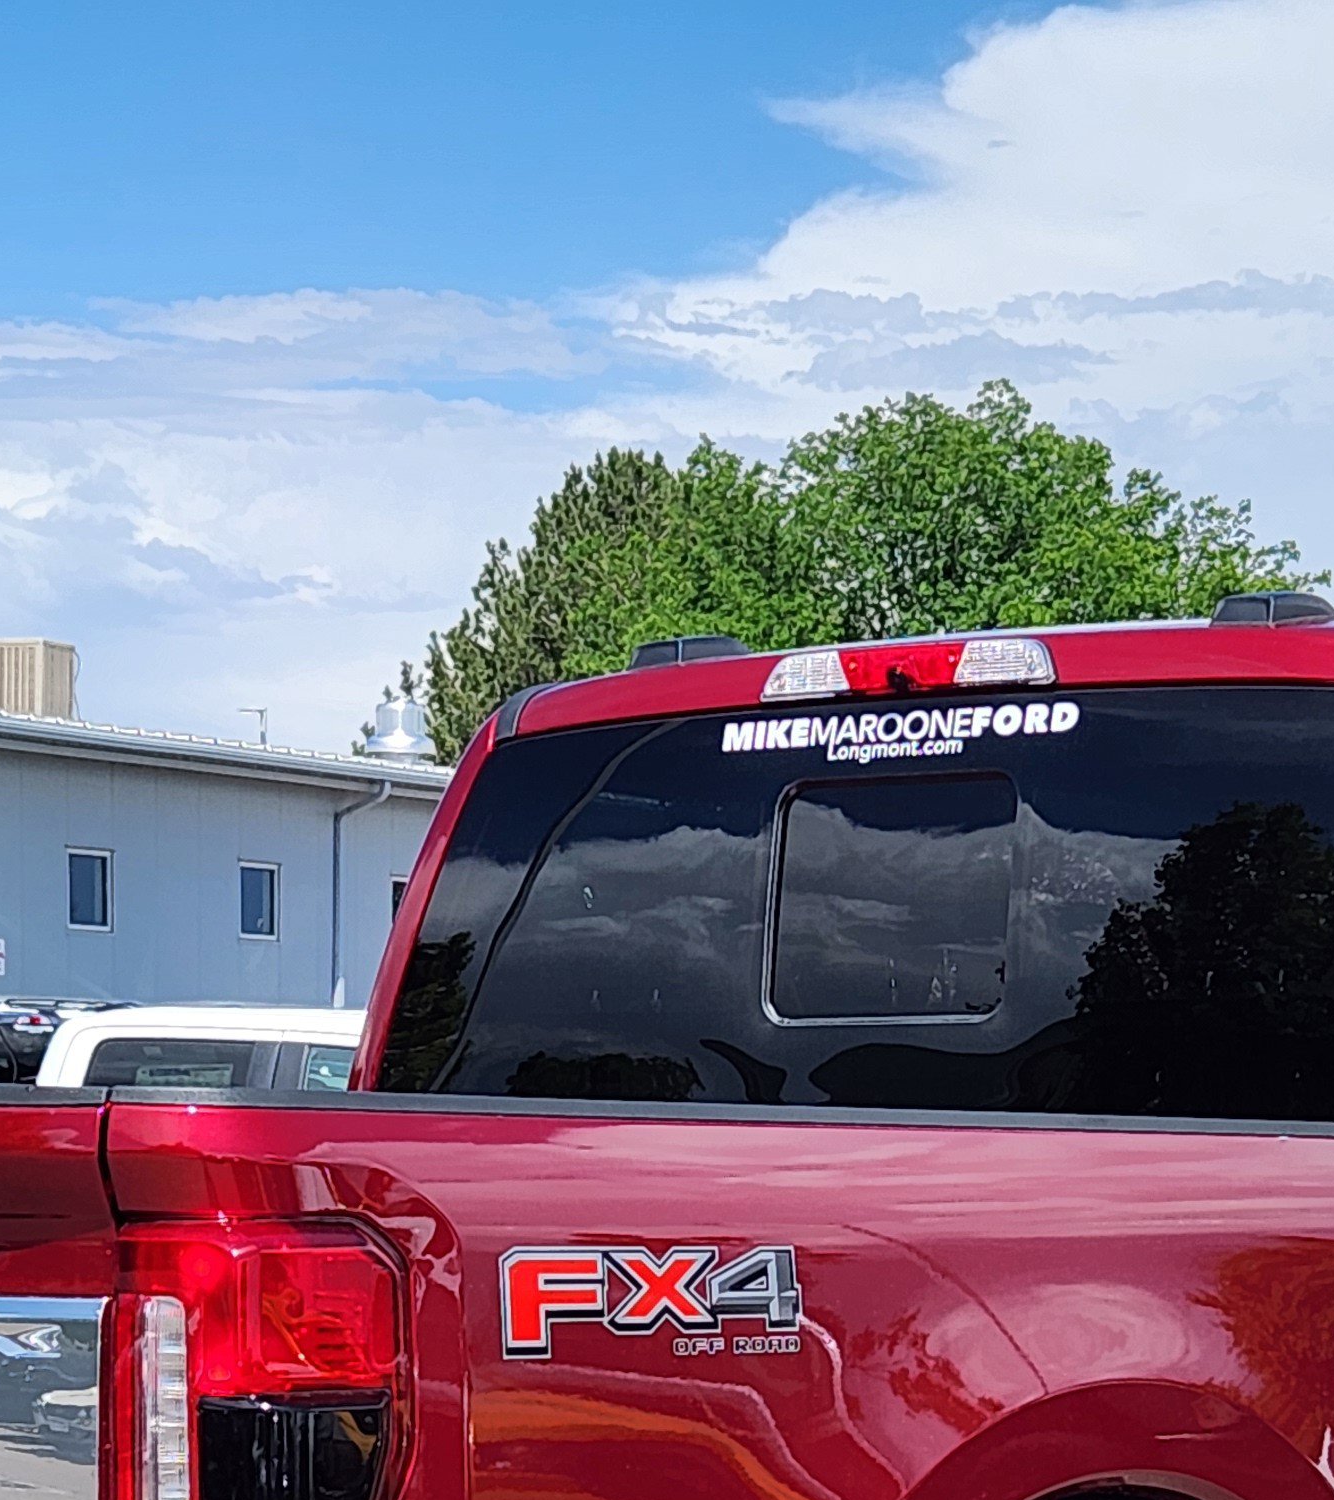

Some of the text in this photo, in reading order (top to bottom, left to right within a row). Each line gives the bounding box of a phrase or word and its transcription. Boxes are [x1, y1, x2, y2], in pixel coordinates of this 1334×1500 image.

[826, 738, 963, 764] Longmont.com
[498, 1245, 802, 1360] FX4
[672, 1335, 801, 1356] OFF ROAD
